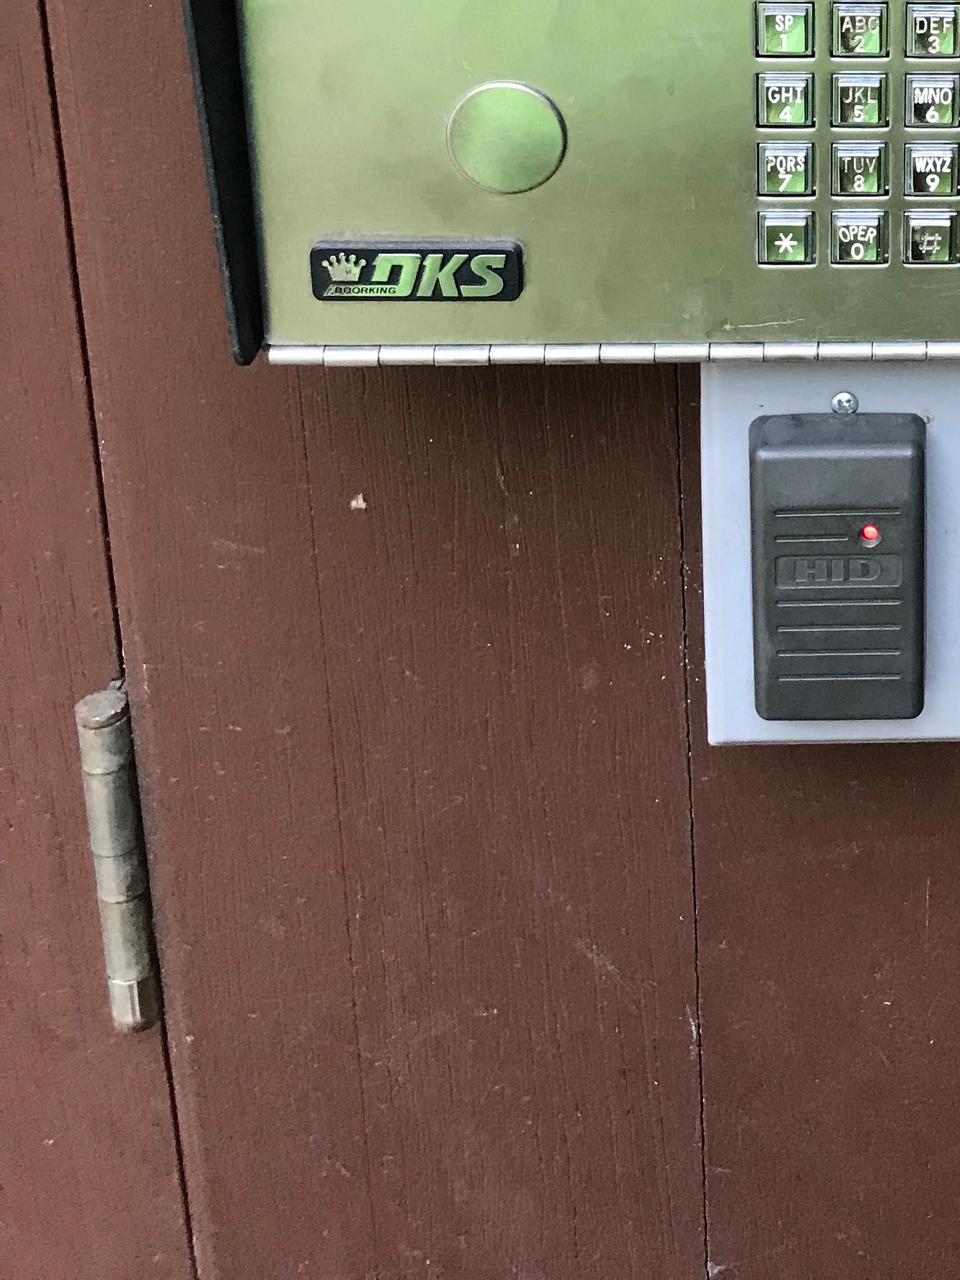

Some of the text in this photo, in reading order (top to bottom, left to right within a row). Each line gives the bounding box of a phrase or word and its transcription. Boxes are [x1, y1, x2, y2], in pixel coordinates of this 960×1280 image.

[775, 14, 794, 32] SP
[841, 16, 880, 34] ABC
[915, 16, 953, 34] DEF
[779, 33, 787, 52] 1
[850, 35, 865, 53] 2
[927, 36, 940, 54] 3
[767, 86, 803, 104] GHI
[842, 87, 877, 104] JKL
[914, 86, 953, 105] MNO
[779, 105, 793, 123] 4
[853, 104, 864, 123] 5
[925, 106, 939, 124] 6
[767, 155, 805, 174] PQRS
[841, 157, 878, 173] TUV
[914, 156, 952, 173] WXYZ
[777, 173, 793, 192] 7
[853, 174, 864, 192] 8
[925, 174, 940, 192] 9
[838, 225, 877, 243] OPER
[371, 252, 507, 297] DKS
[795, 558, 882, 582] HID
